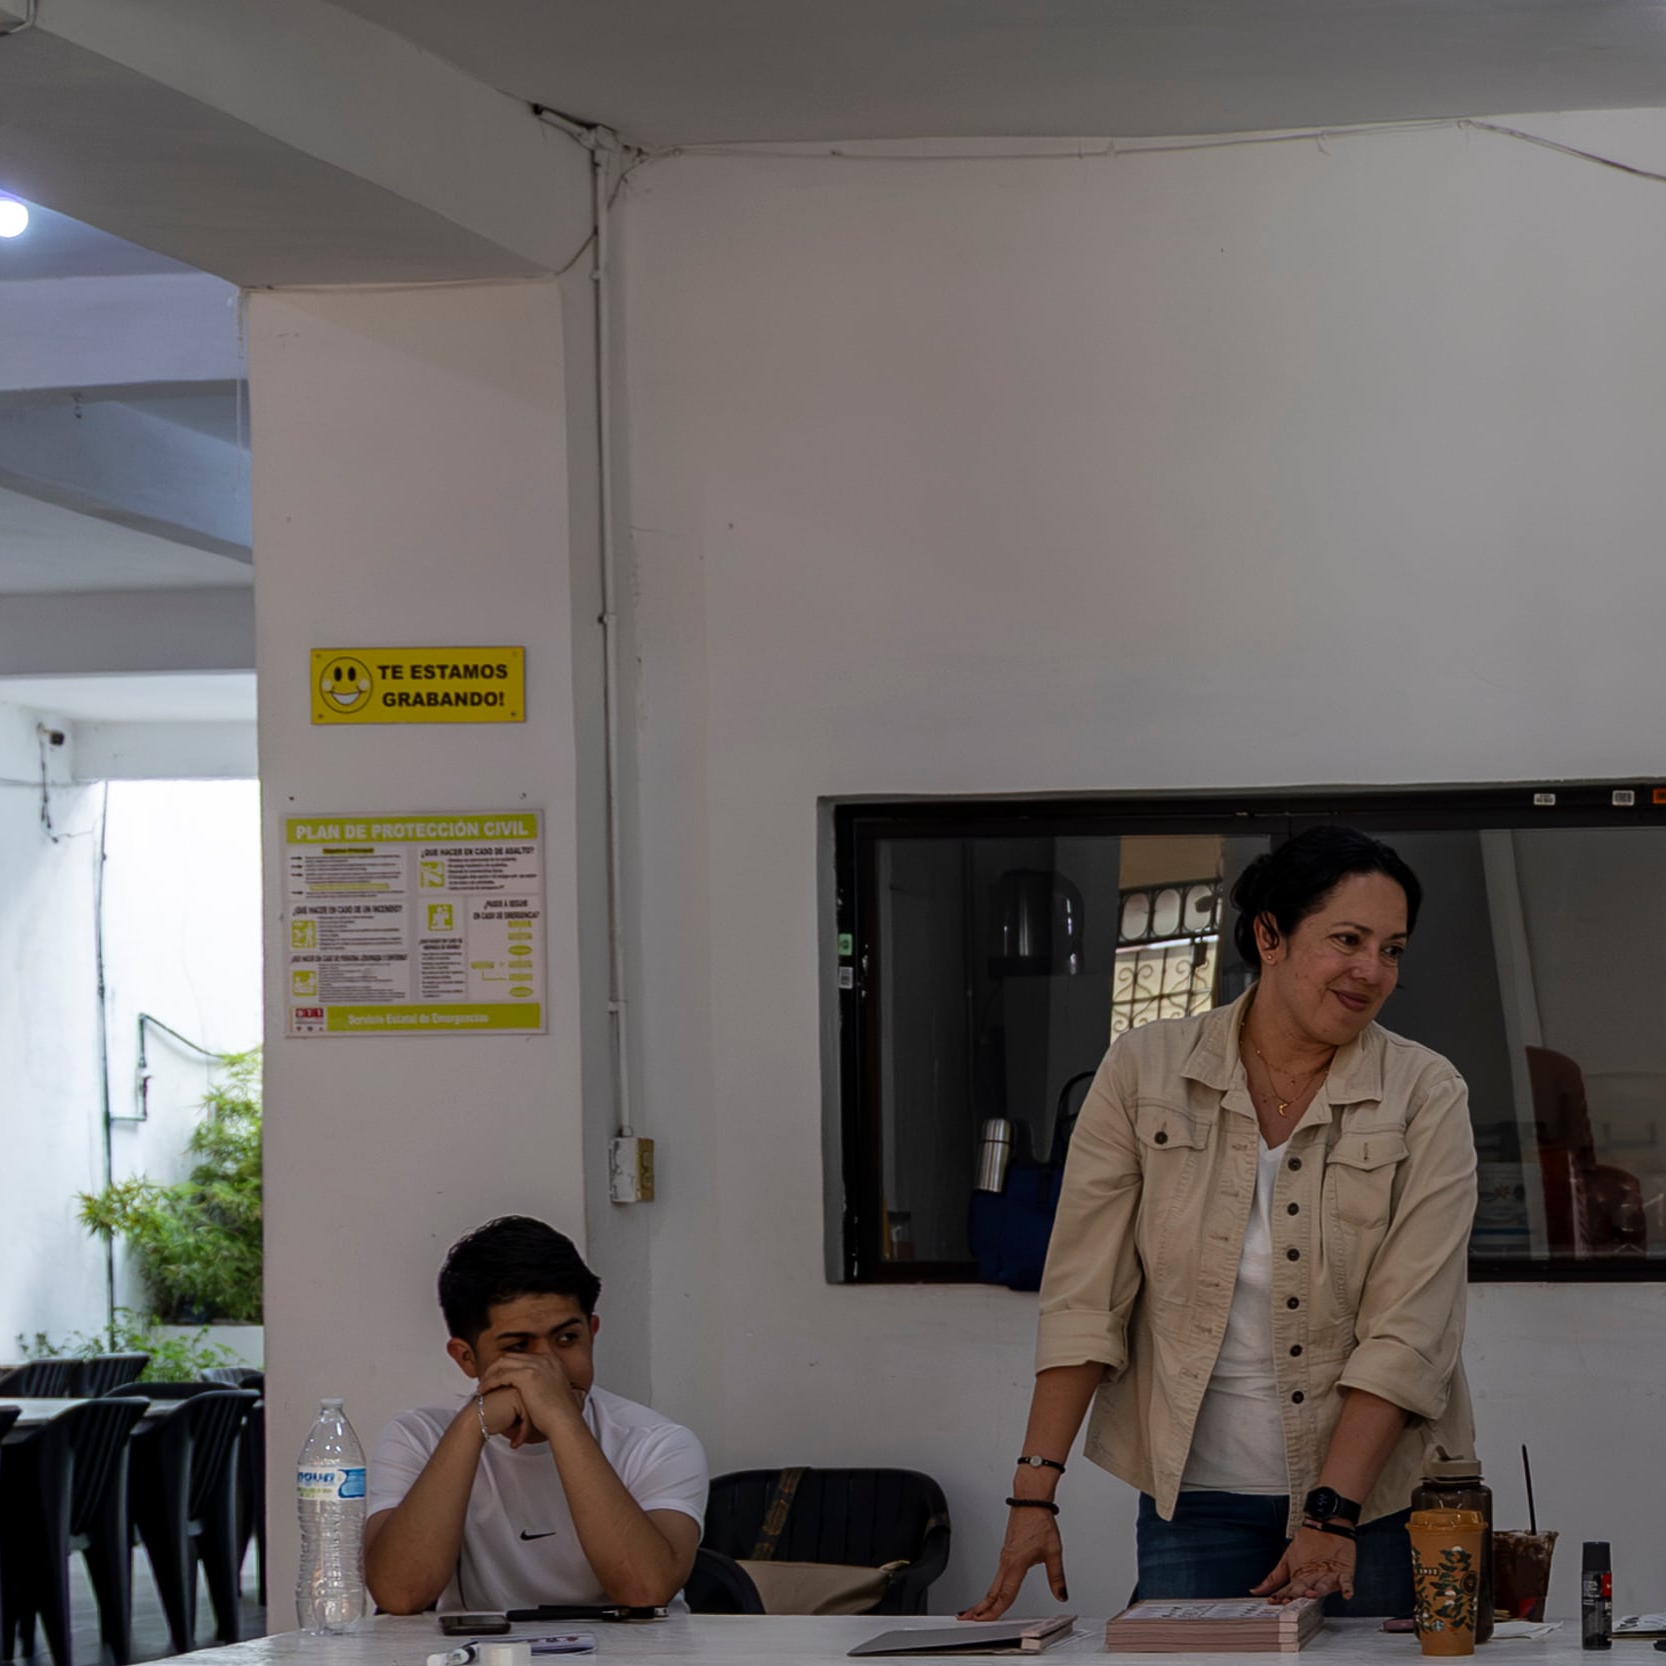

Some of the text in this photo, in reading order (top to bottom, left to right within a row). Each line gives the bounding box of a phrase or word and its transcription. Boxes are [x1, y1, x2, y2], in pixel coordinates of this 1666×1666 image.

[377, 663, 508, 680] TE ESTAMOS
[382, 691, 504, 708] GRABANDO!
[296, 820, 528, 840] PLAN DE PROTECCIÓN CIVIL
